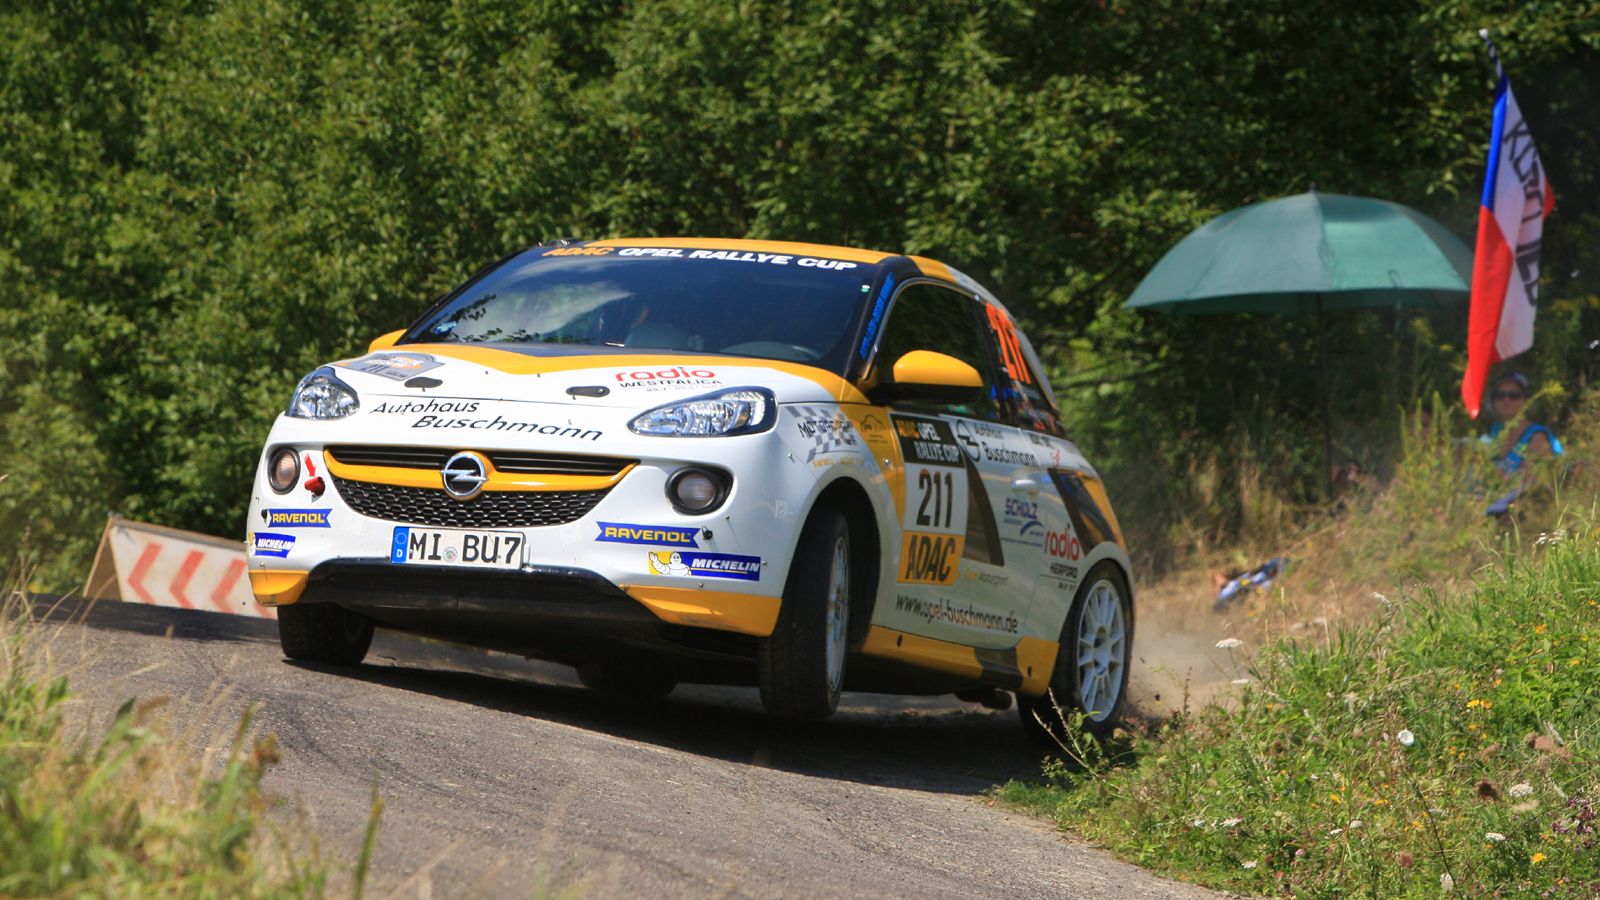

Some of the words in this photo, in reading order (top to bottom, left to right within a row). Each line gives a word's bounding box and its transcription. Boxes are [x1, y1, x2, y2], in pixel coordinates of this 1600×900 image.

[542, 247, 614, 257] ADAC
[618, 248, 683, 258] OPEL
[688, 249, 788, 265] RALLYE
[796, 258, 858, 270] CUP
[615, 367, 715, 382] radio
[619, 379, 722, 388] WESTFALICA
[370, 399, 480, 414] Autohaus
[411, 416, 603, 441] Buschmann
[913, 441, 945, 461] RALLYE
[982, 441, 1040, 467] Buschmann
[916, 468, 951, 528] 211
[1004, 497, 1038, 519] SCHOLZ
[272, 513, 326, 524] RAVENOL
[258, 539, 295, 551] MICHELIN
[605, 527, 691, 543] RAVENOL
[1044, 523, 1080, 561] radio
[396, 548, 403, 558] D
[408, 532, 442, 561] MI
[692, 558, 760, 572] MICHELIN
[905, 535, 956, 582] ADAC
